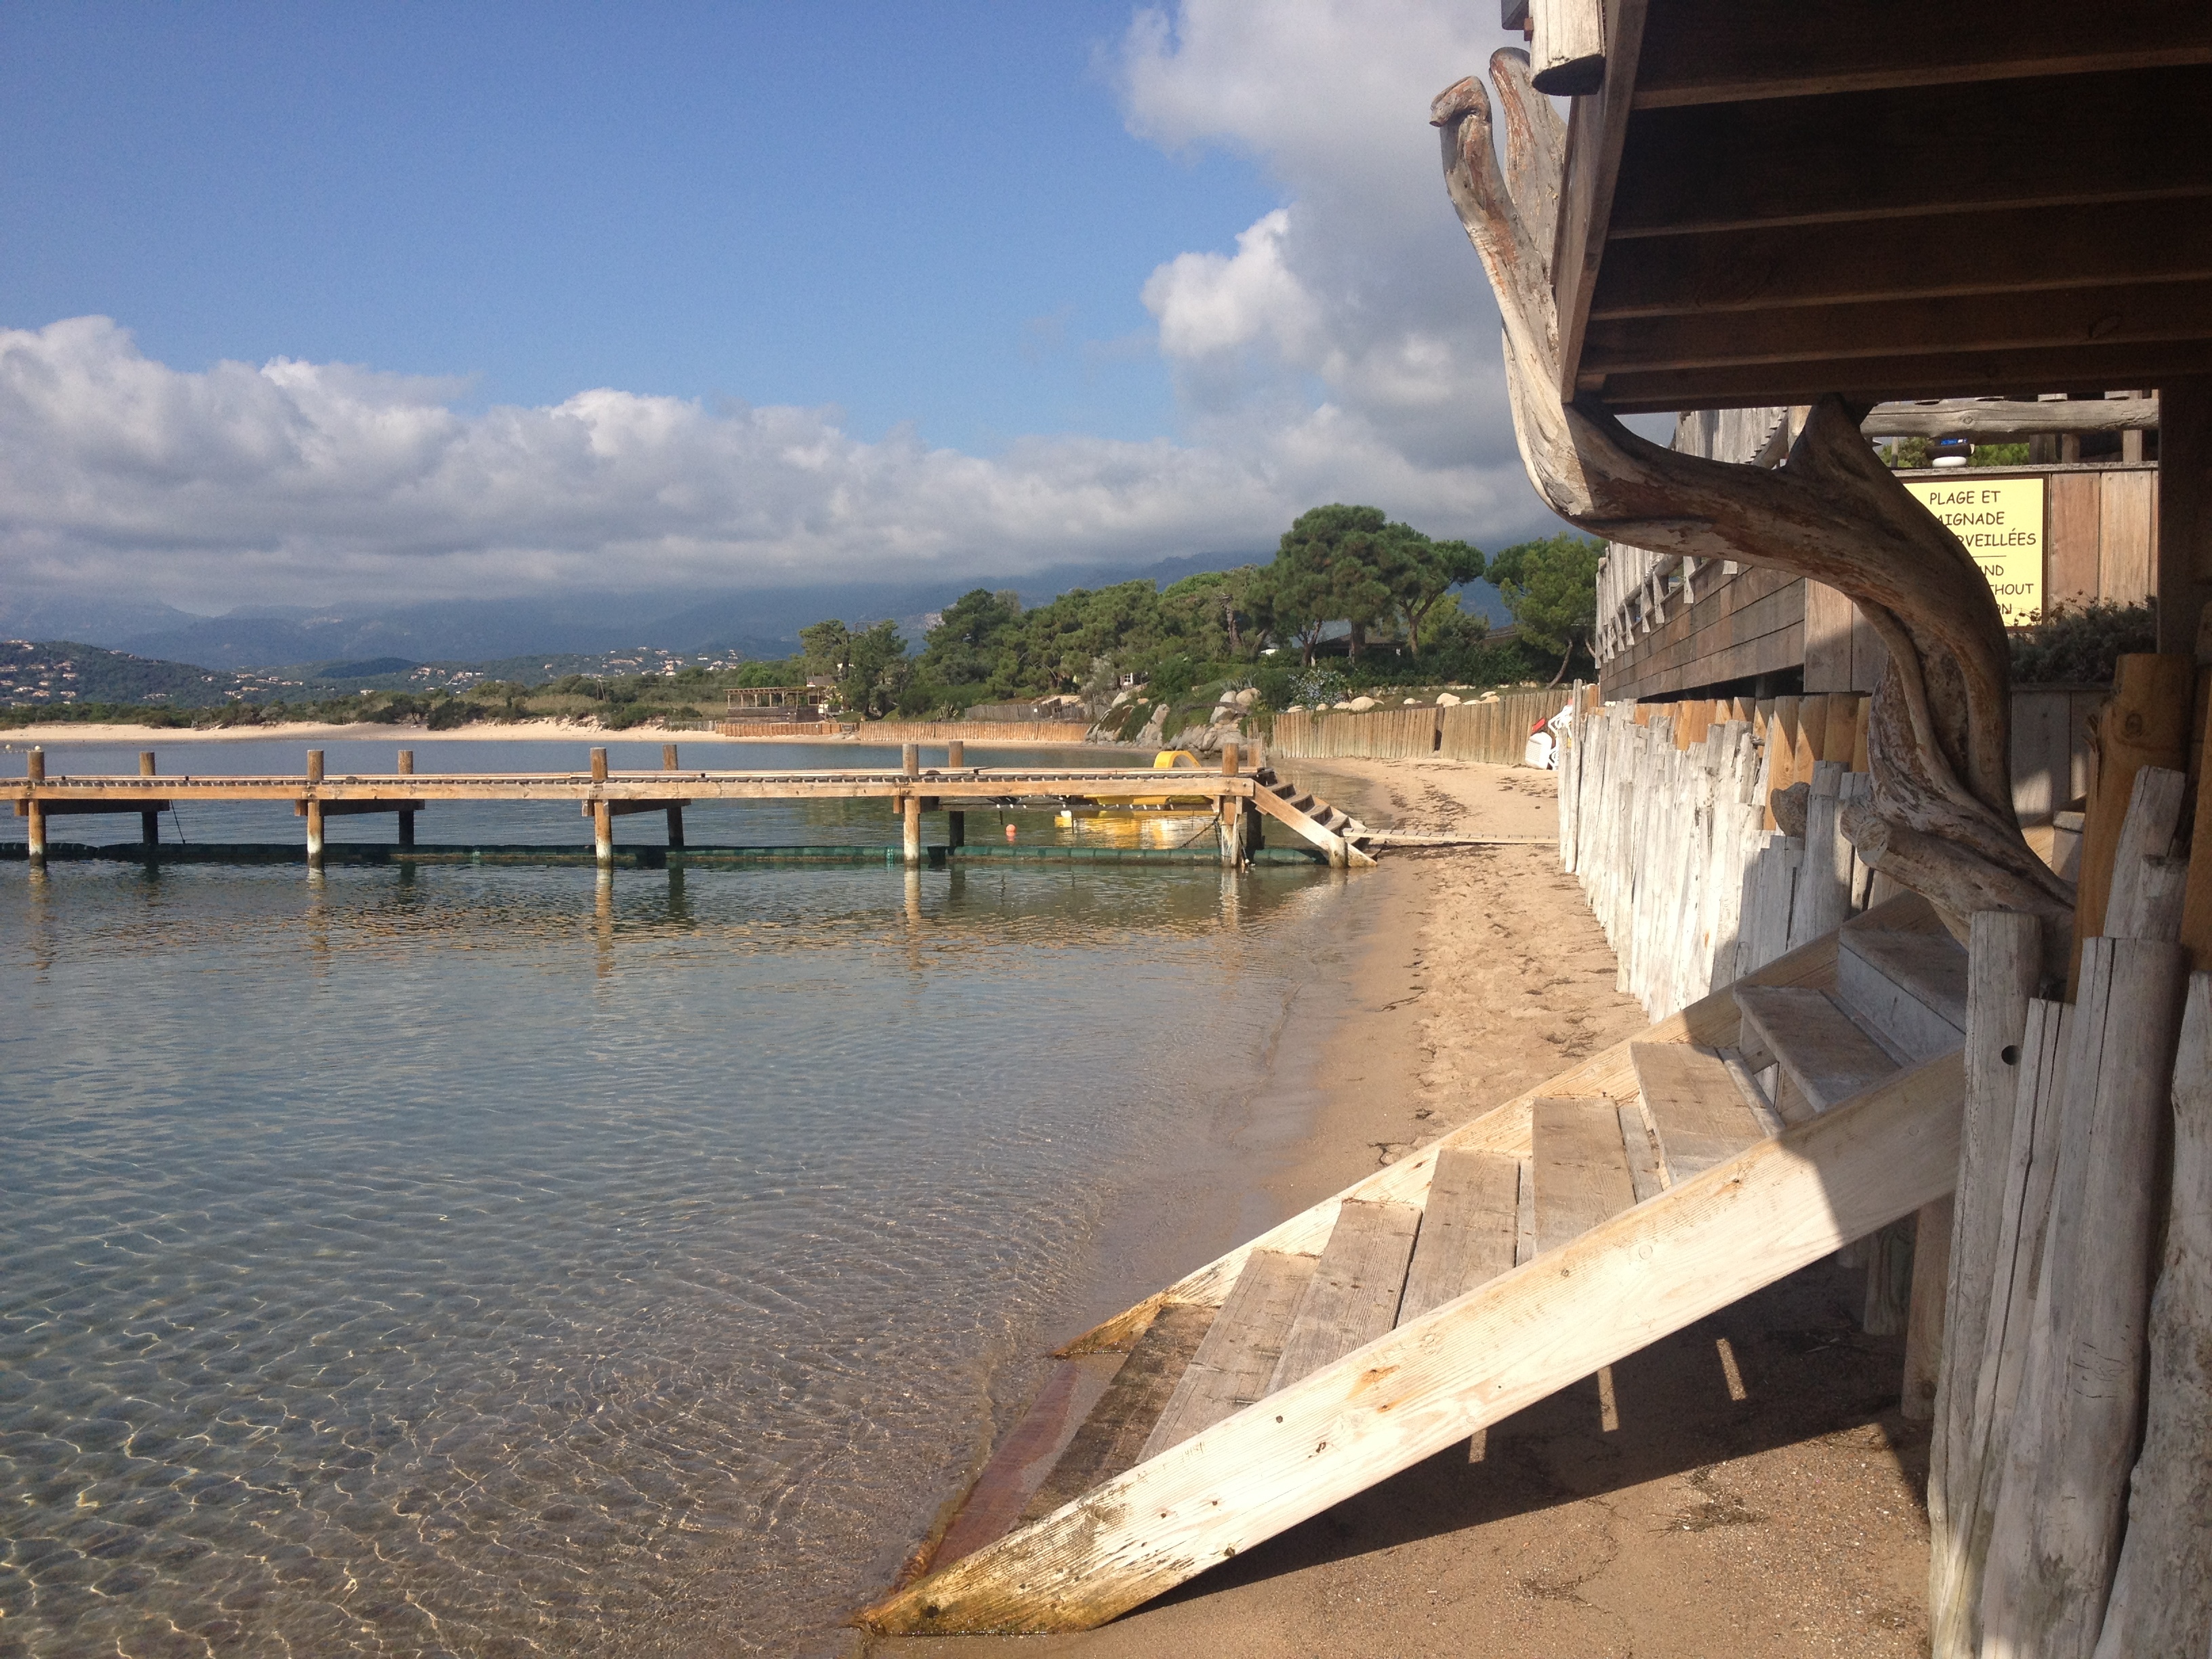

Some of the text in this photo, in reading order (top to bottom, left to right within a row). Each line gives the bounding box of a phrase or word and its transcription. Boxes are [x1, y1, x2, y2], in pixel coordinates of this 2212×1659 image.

[1929, 490, 2001, 505] PLAGE ET
[1936, 511, 2005, 526] AIGNADE
[1957, 528, 2036, 547] VEILLÉES
